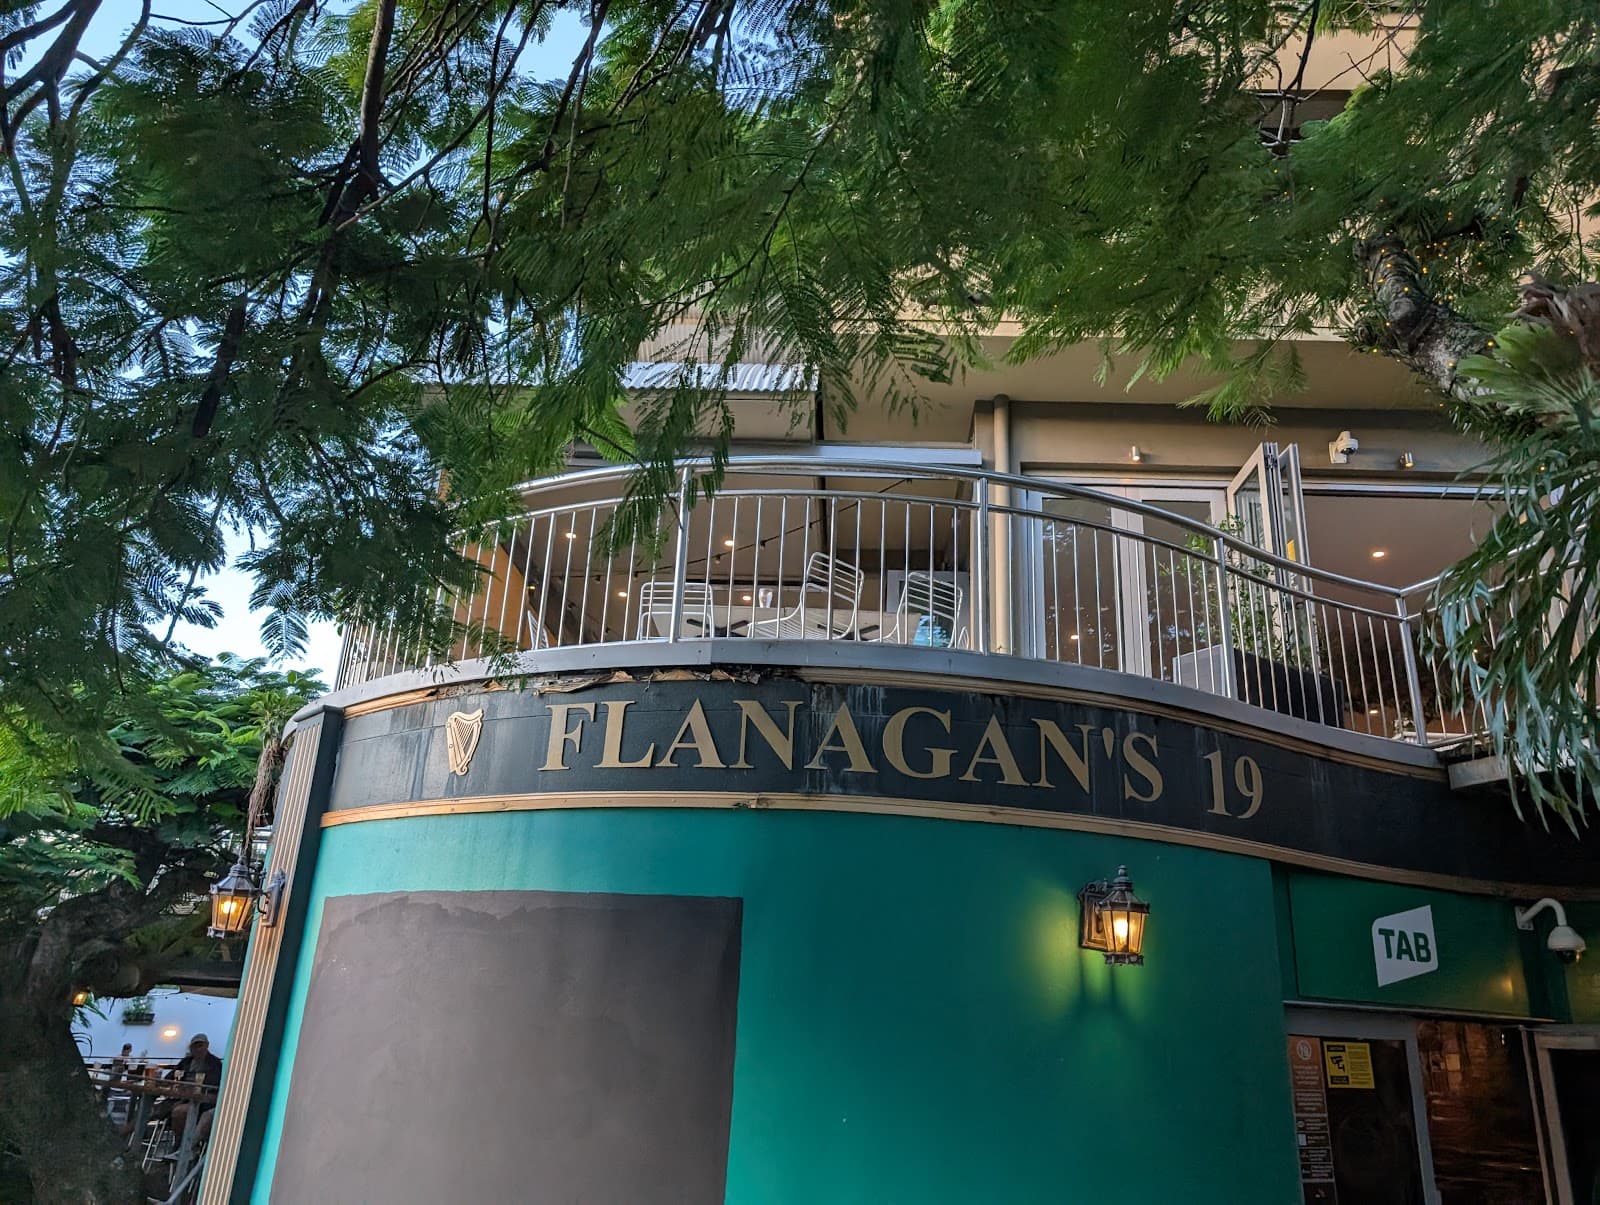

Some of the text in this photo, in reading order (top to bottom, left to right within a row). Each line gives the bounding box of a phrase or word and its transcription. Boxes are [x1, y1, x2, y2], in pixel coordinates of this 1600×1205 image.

[537, 697, 1264, 819] FLANAGAN'S 19
[1378, 928, 1431, 962] TAB
